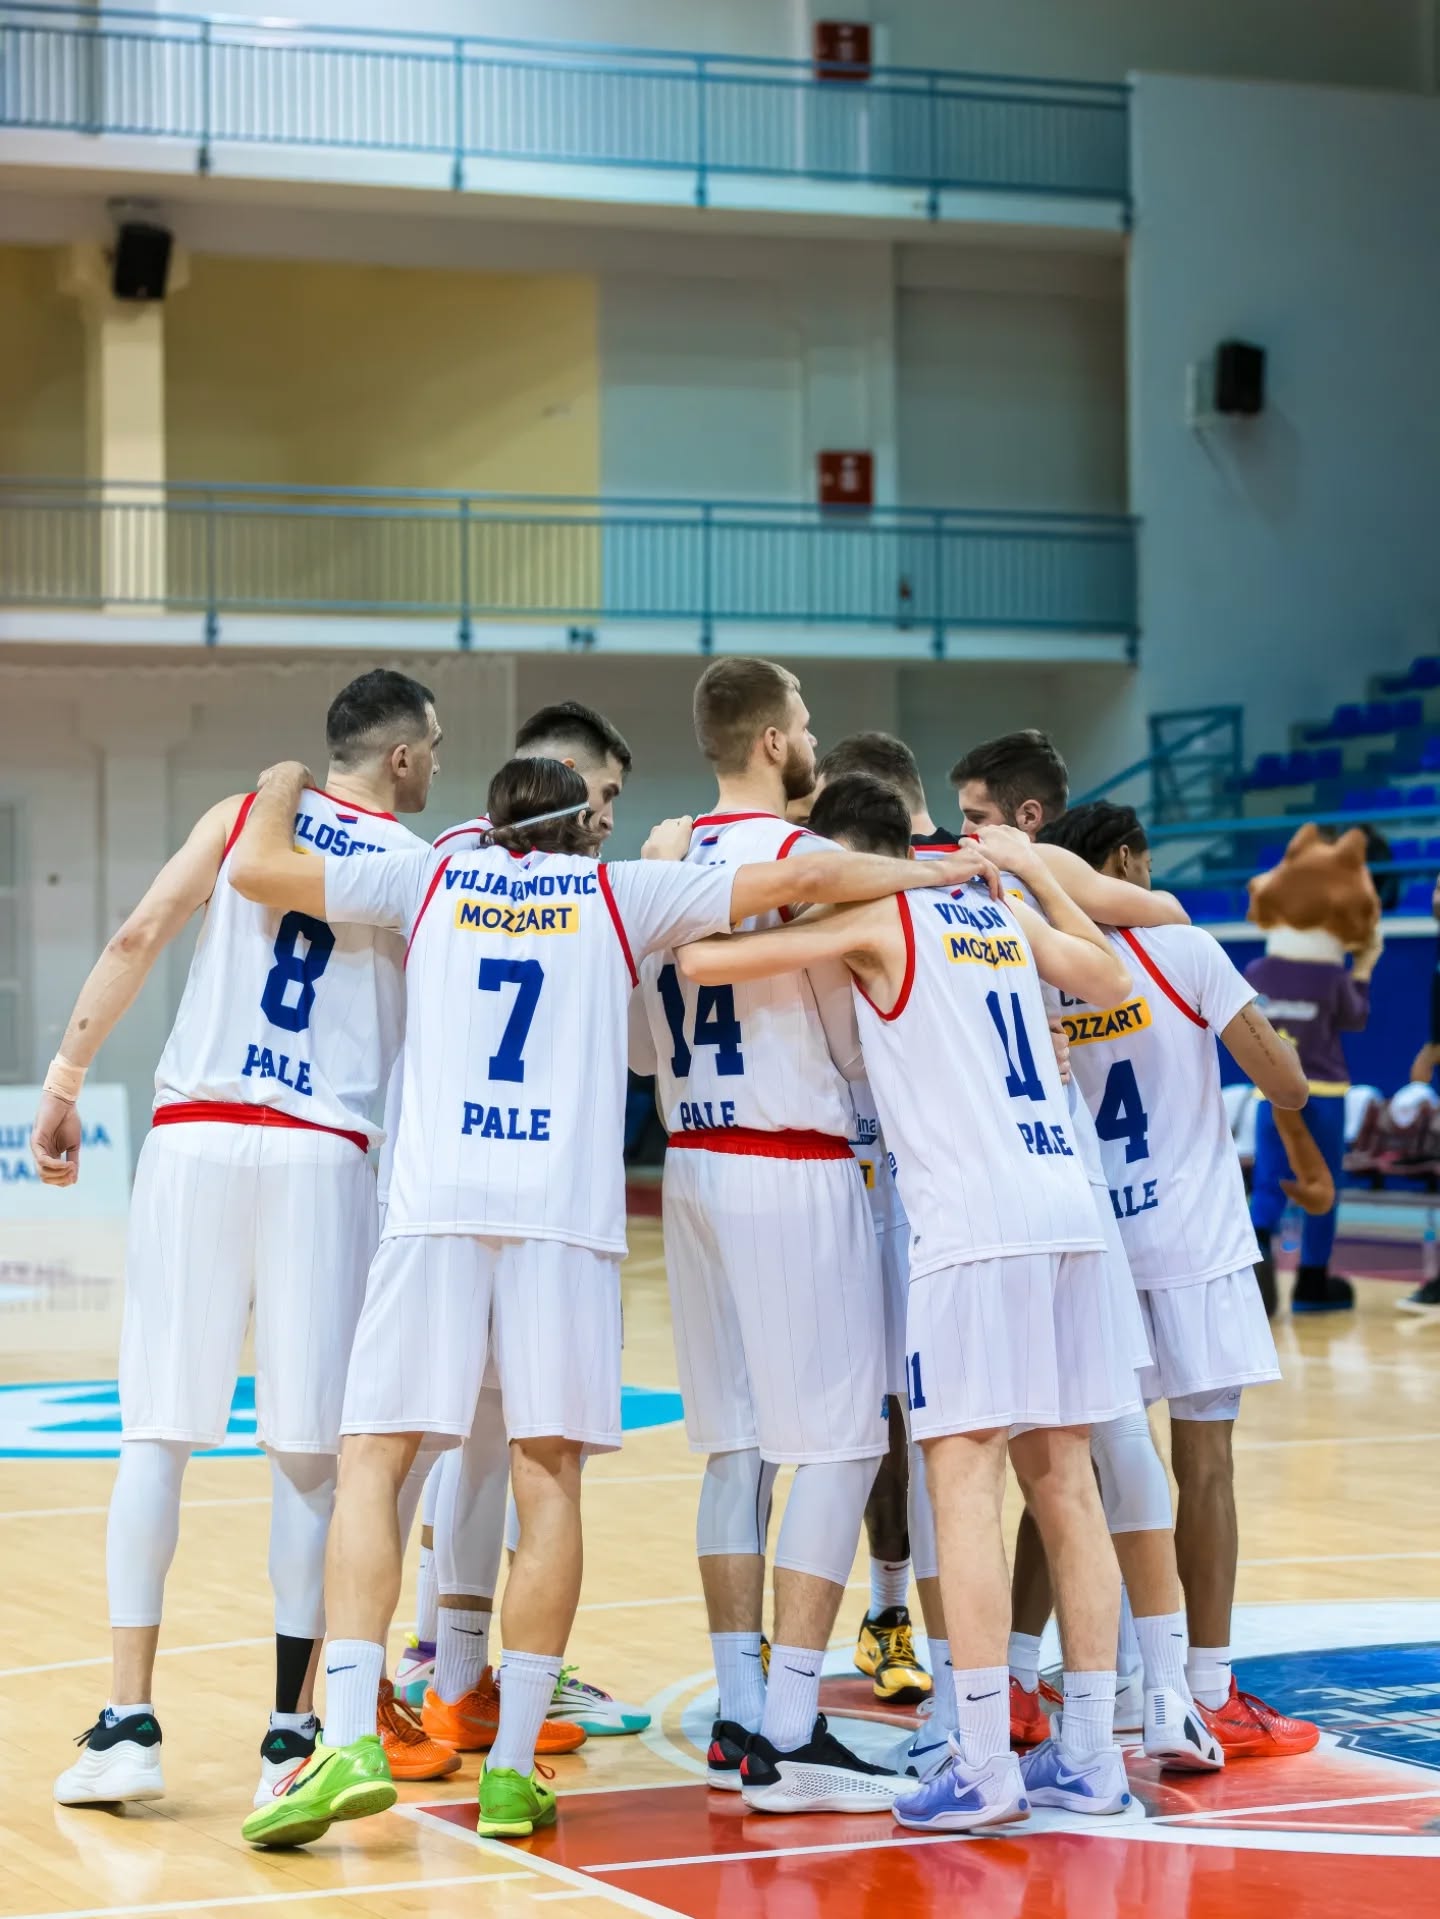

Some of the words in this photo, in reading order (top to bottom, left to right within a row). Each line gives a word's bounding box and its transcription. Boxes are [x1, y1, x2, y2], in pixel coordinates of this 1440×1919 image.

[460, 903, 572, 933] MOZZART
[260, 911, 336, 1033] 8
[478, 958, 544, 1083] 7
[657, 963, 744, 1078] 14
[985, 990, 1046, 1101] 11
[1060, 1003, 1143, 1042] OZZART
[242, 1044, 313, 1096] PALE
[461, 1101, 551, 1141] PALE
[680, 1101, 738, 1131] PALE
[1095, 1059, 1150, 1164] 4
[905, 1352, 926, 1411] 1
